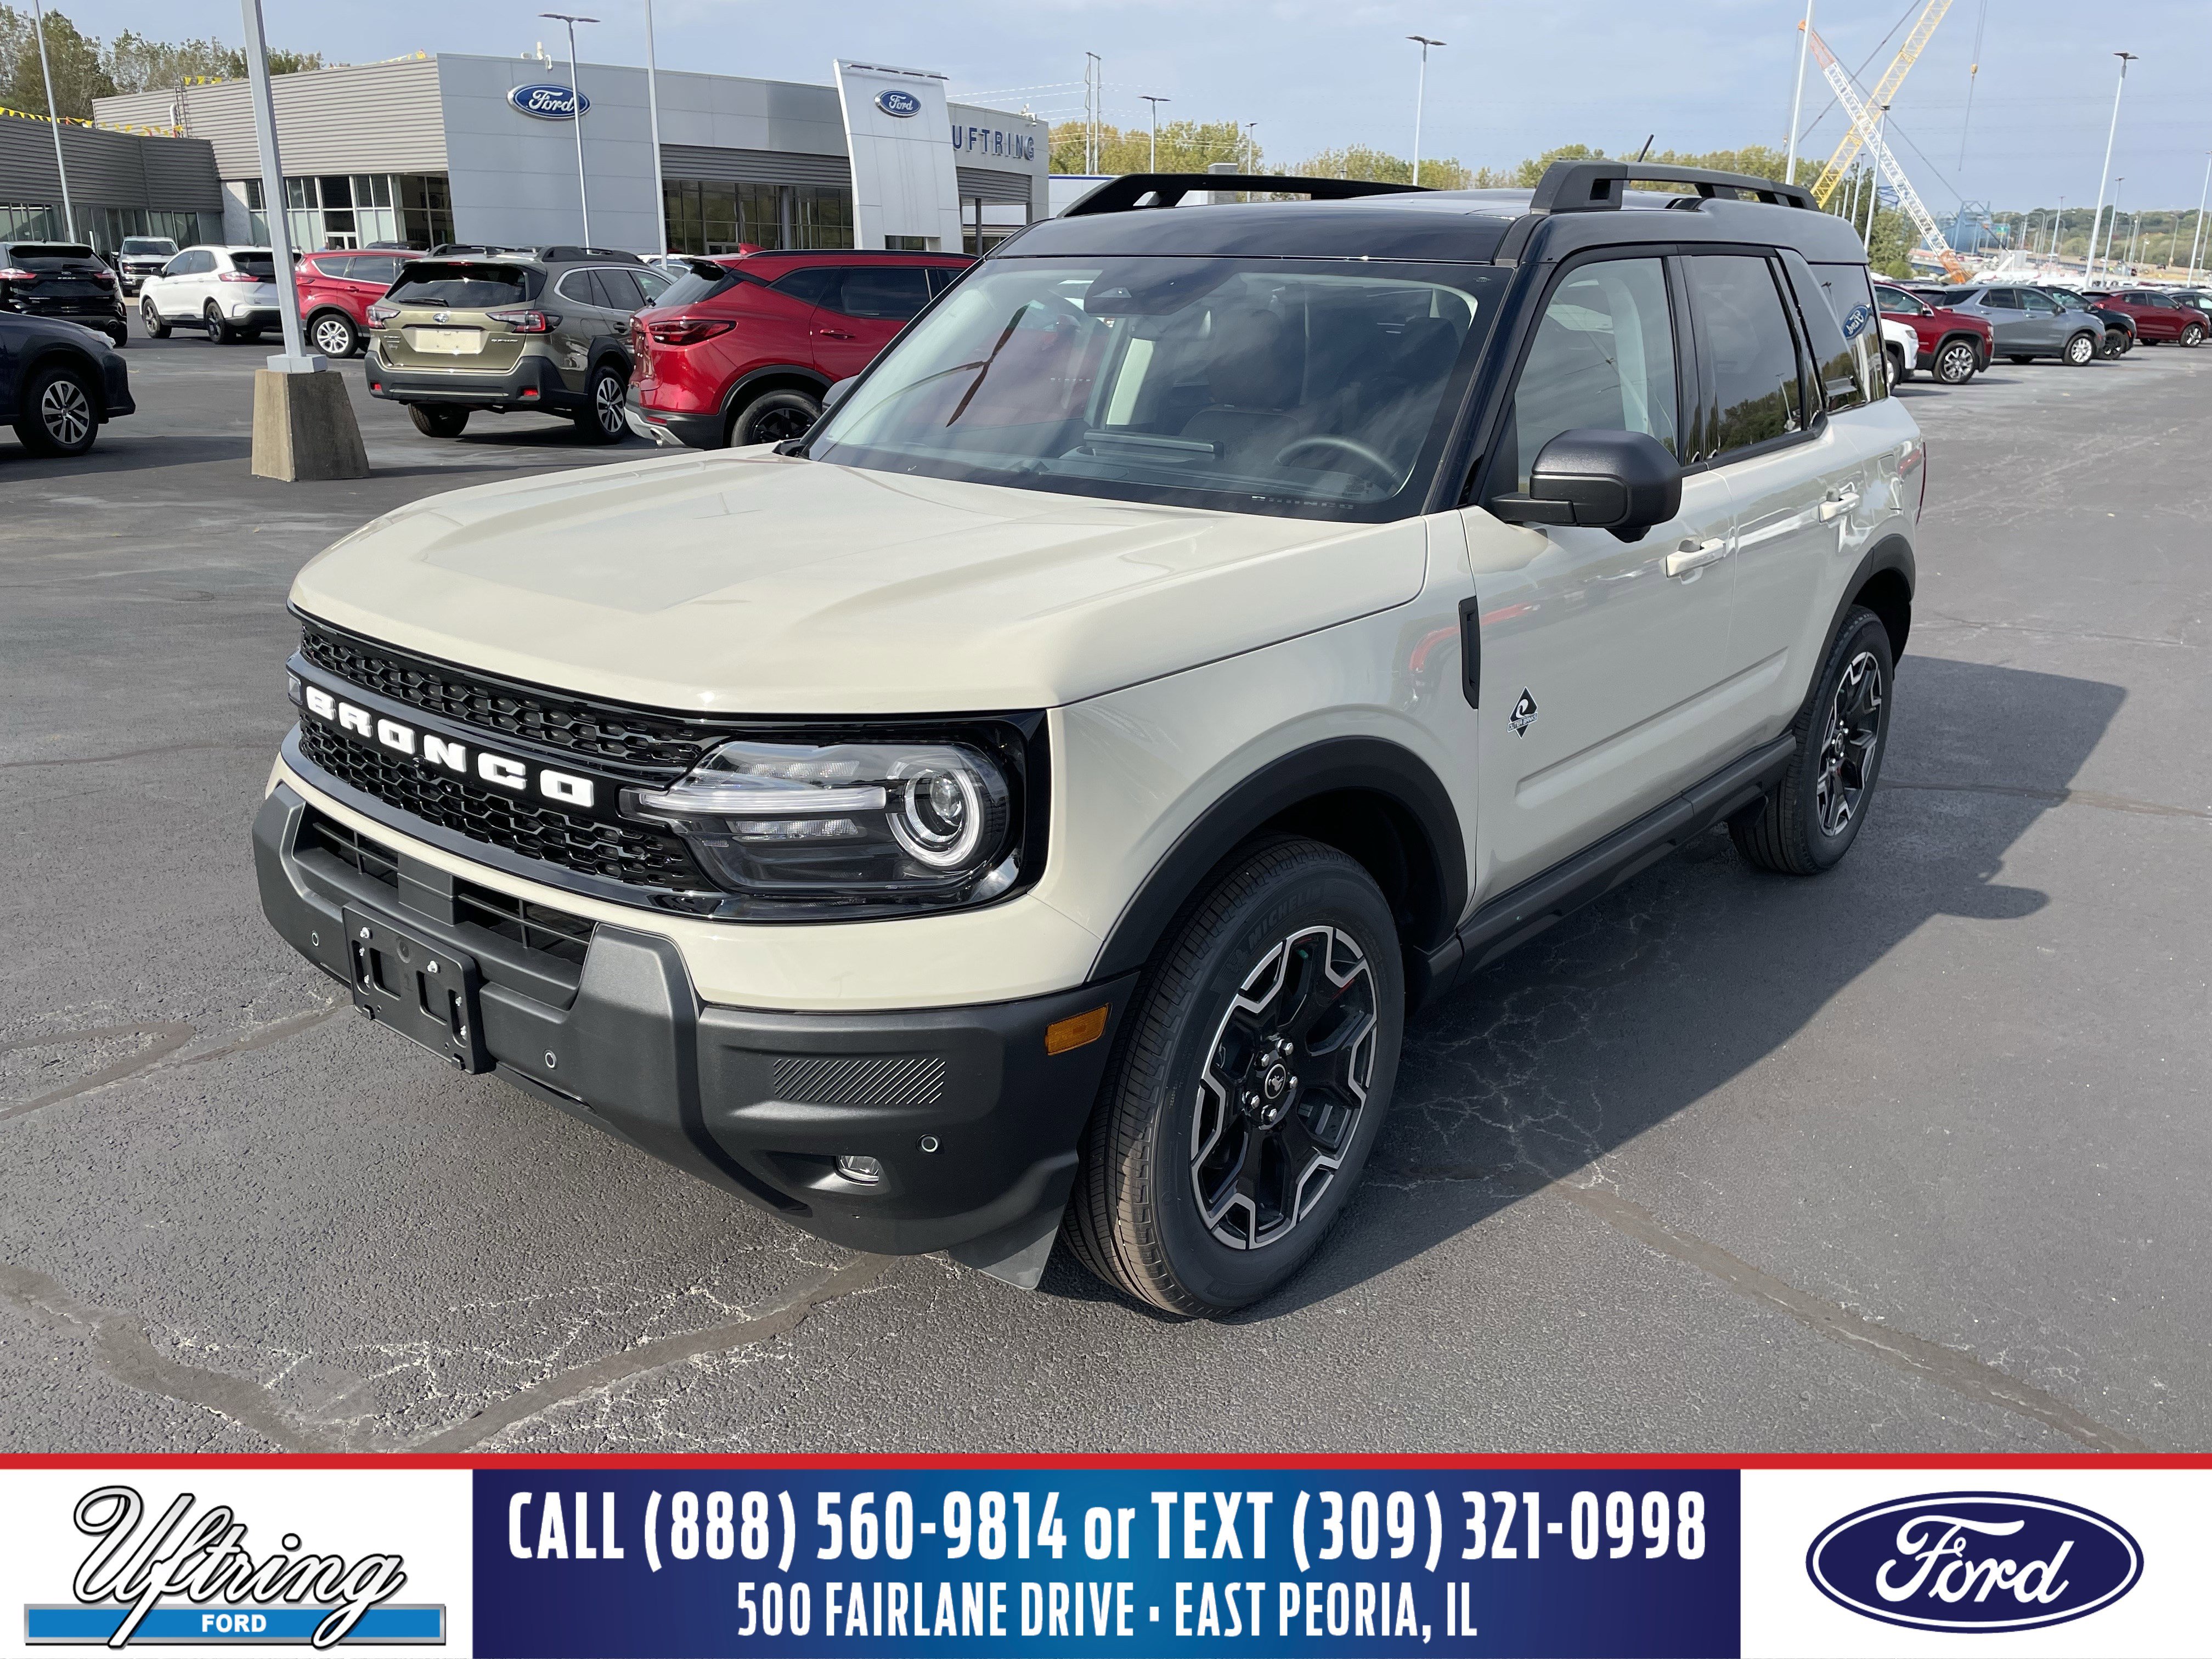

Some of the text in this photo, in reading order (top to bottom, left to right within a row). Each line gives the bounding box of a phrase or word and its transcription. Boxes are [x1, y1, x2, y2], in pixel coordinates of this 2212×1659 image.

[528, 89, 574, 112] Ford
[888, 94, 913, 111] Ford
[952, 125, 1035, 161] UFTRING
[306, 685, 594, 808] BRONCO
